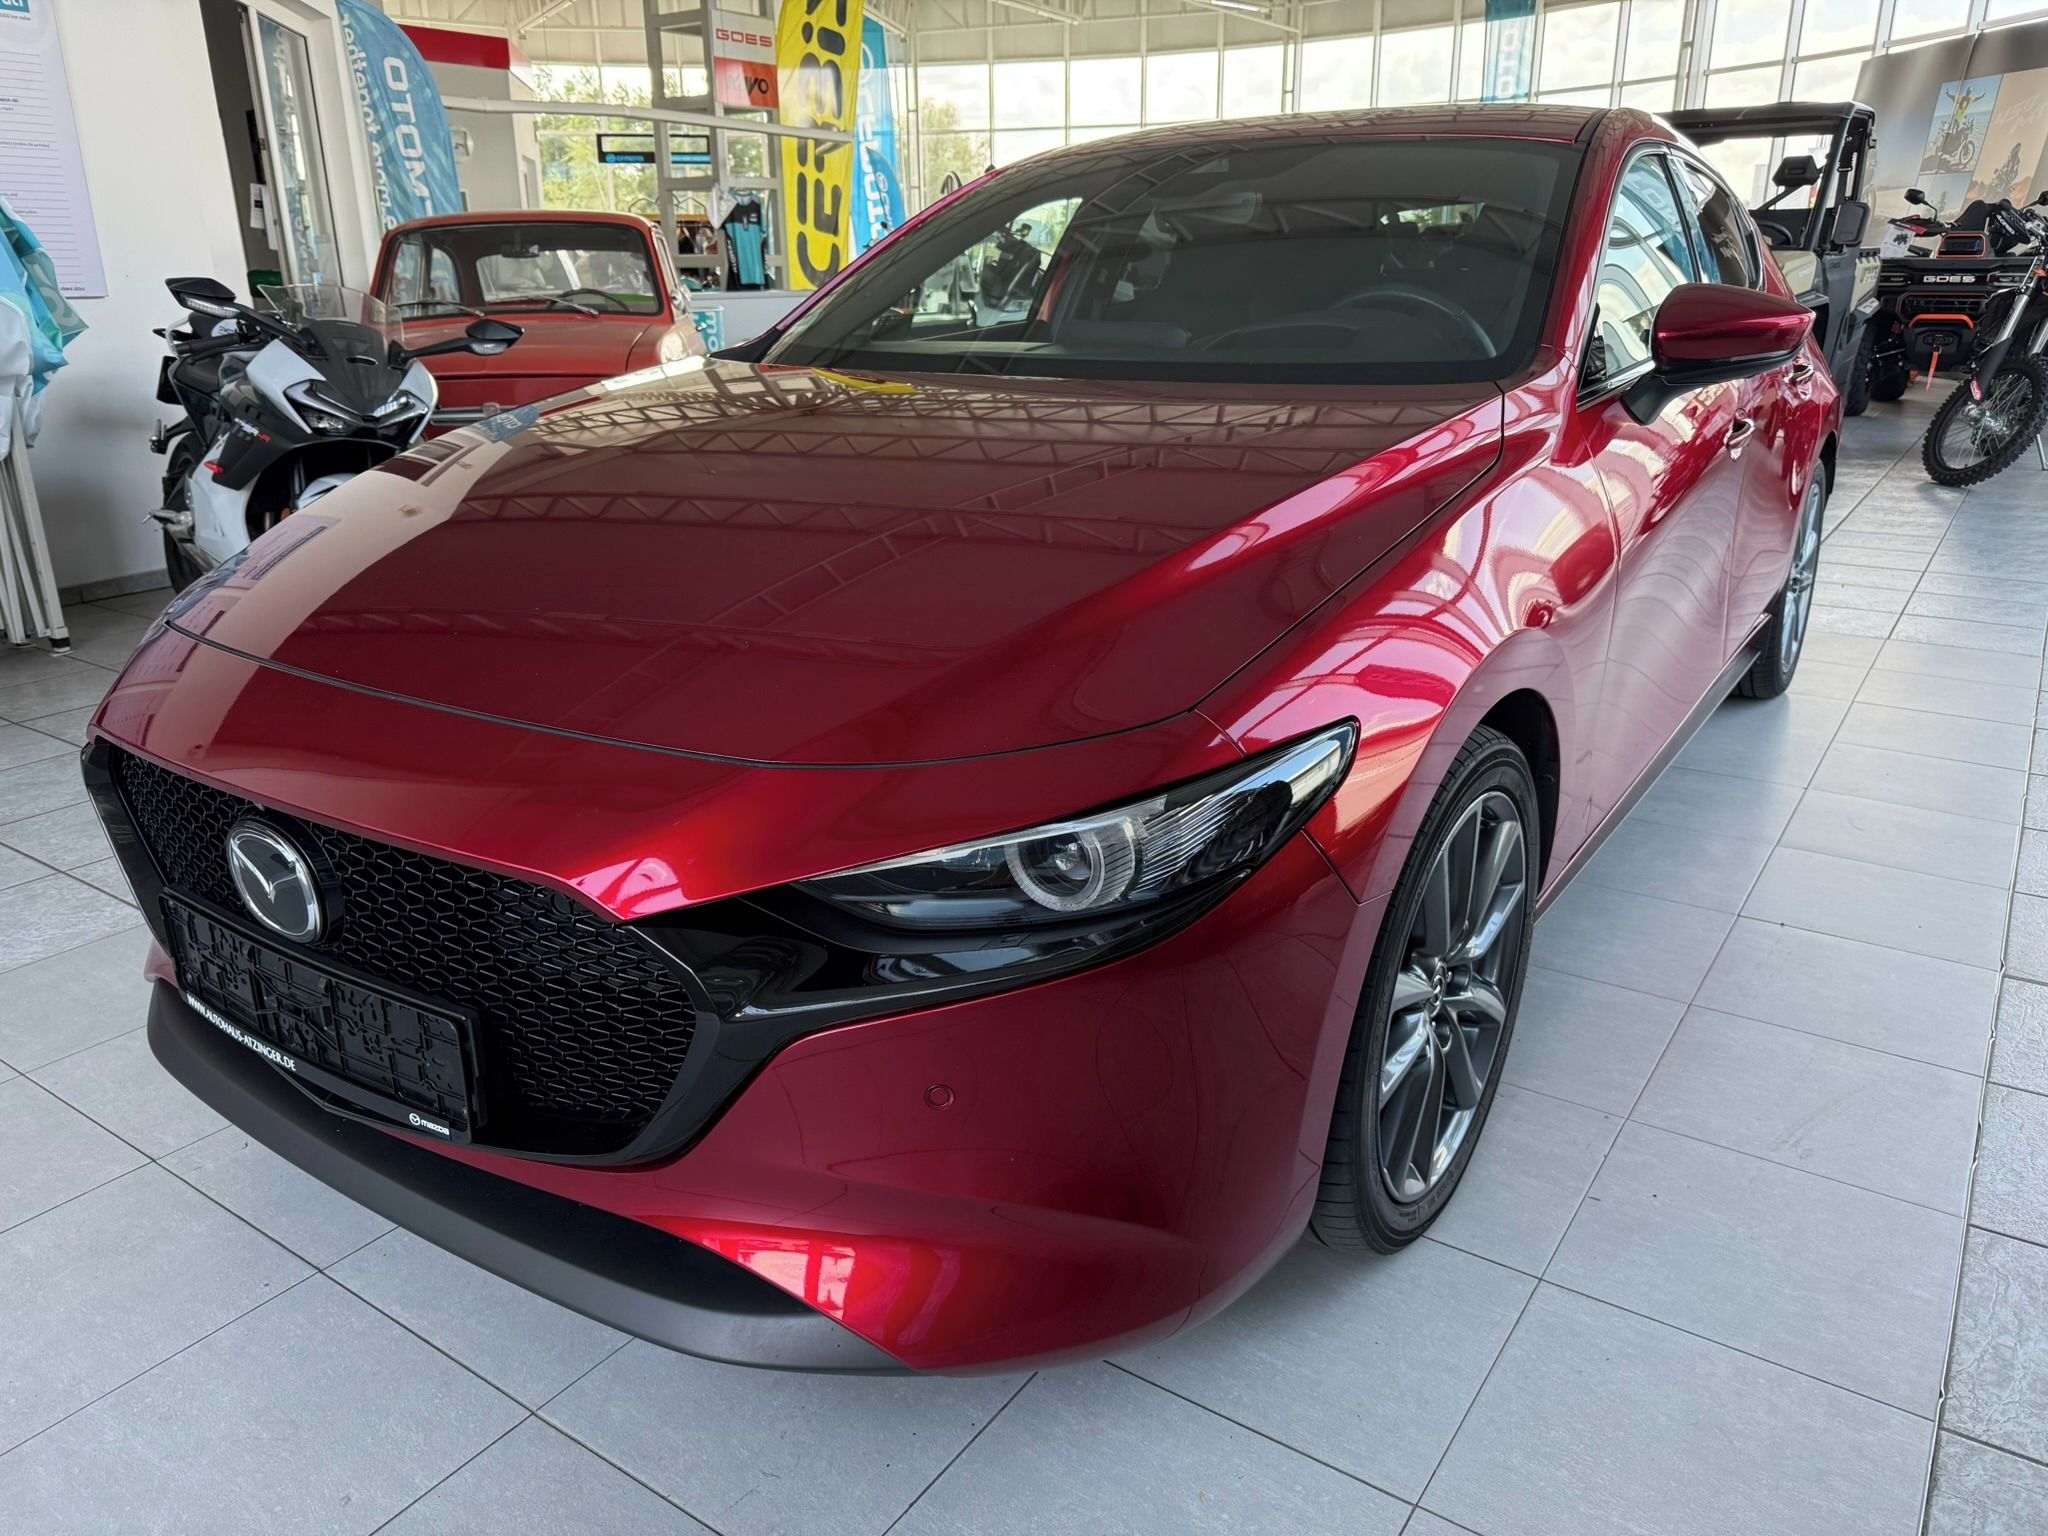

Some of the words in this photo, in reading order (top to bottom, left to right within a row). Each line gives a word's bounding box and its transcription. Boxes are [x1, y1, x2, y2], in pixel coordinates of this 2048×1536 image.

[715, 28, 773, 48] GOES
[1922, 275, 1976, 284] GOES
[186, 993, 297, 1072] WWW.AUTOHAUS-ATZINGER.DE
[420, 1119, 450, 1136] mazda
